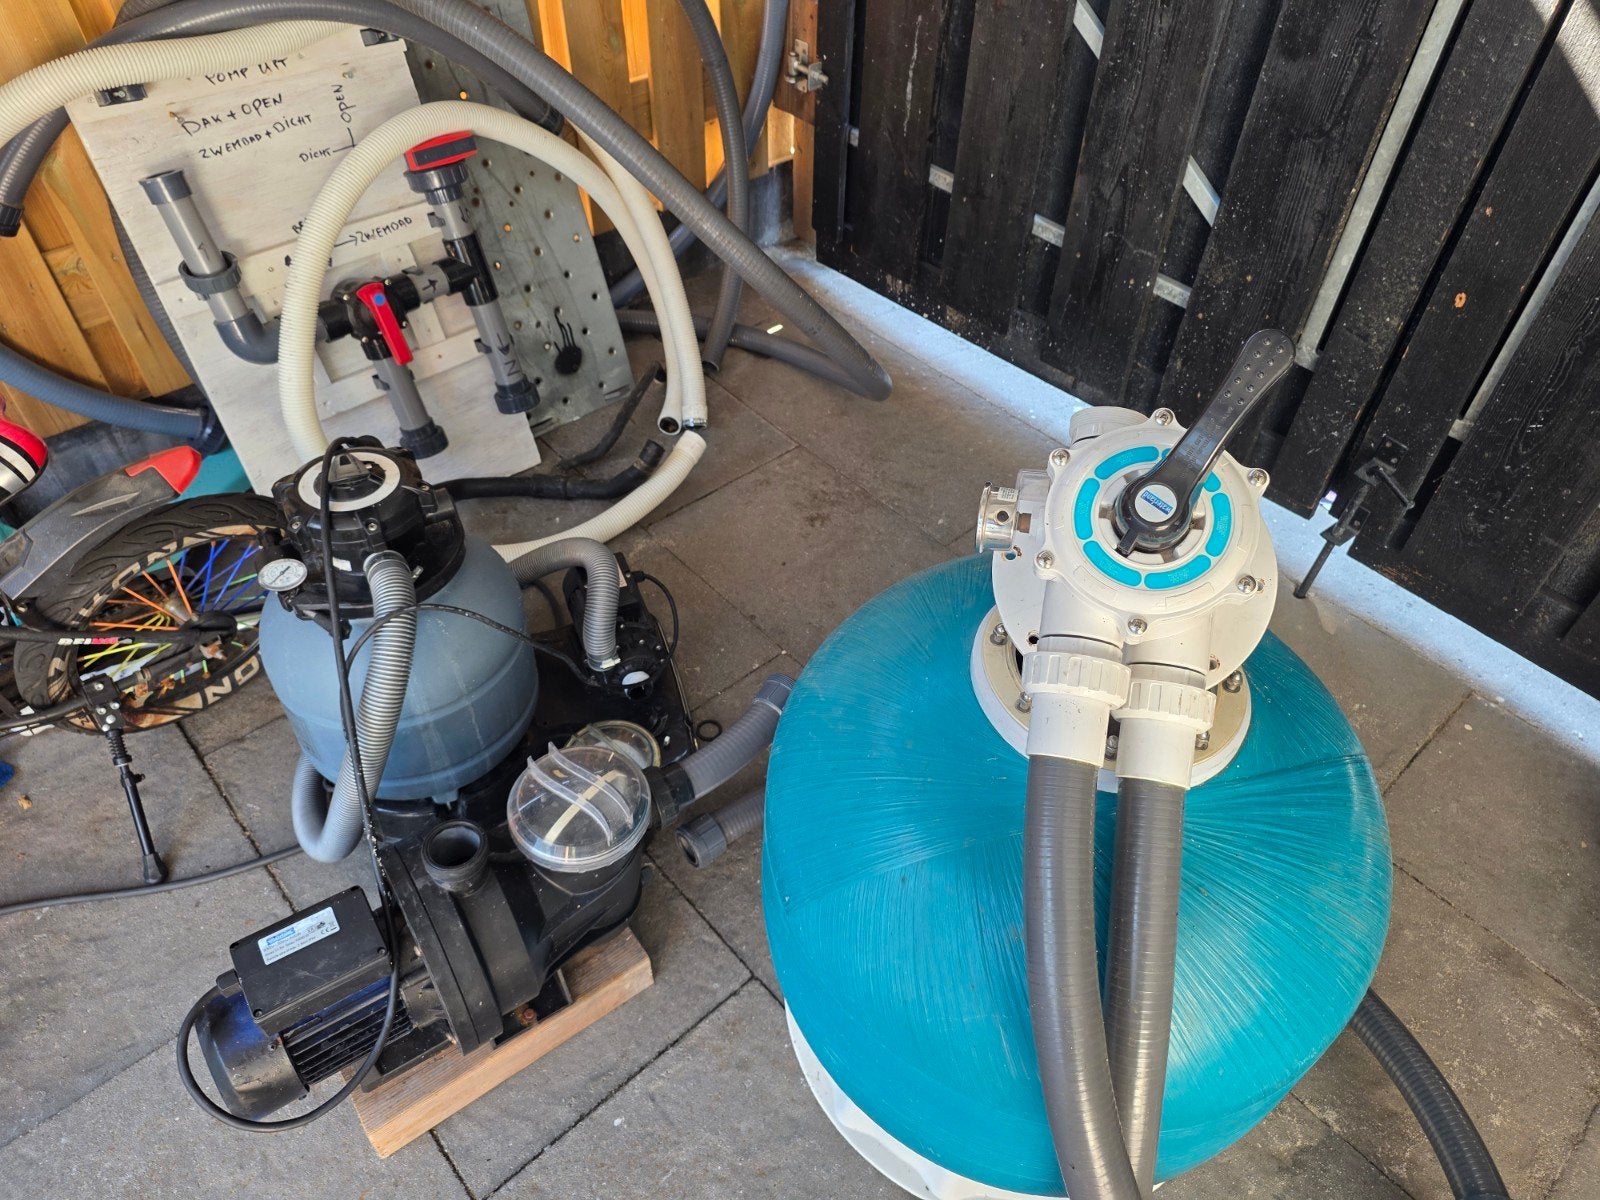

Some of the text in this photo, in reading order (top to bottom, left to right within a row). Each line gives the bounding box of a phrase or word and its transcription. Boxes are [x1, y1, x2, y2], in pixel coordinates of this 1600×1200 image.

[181, 114, 222, 136] DAK
[241, 93, 283, 117] OPEN
[331, 83, 356, 123] OPEN
